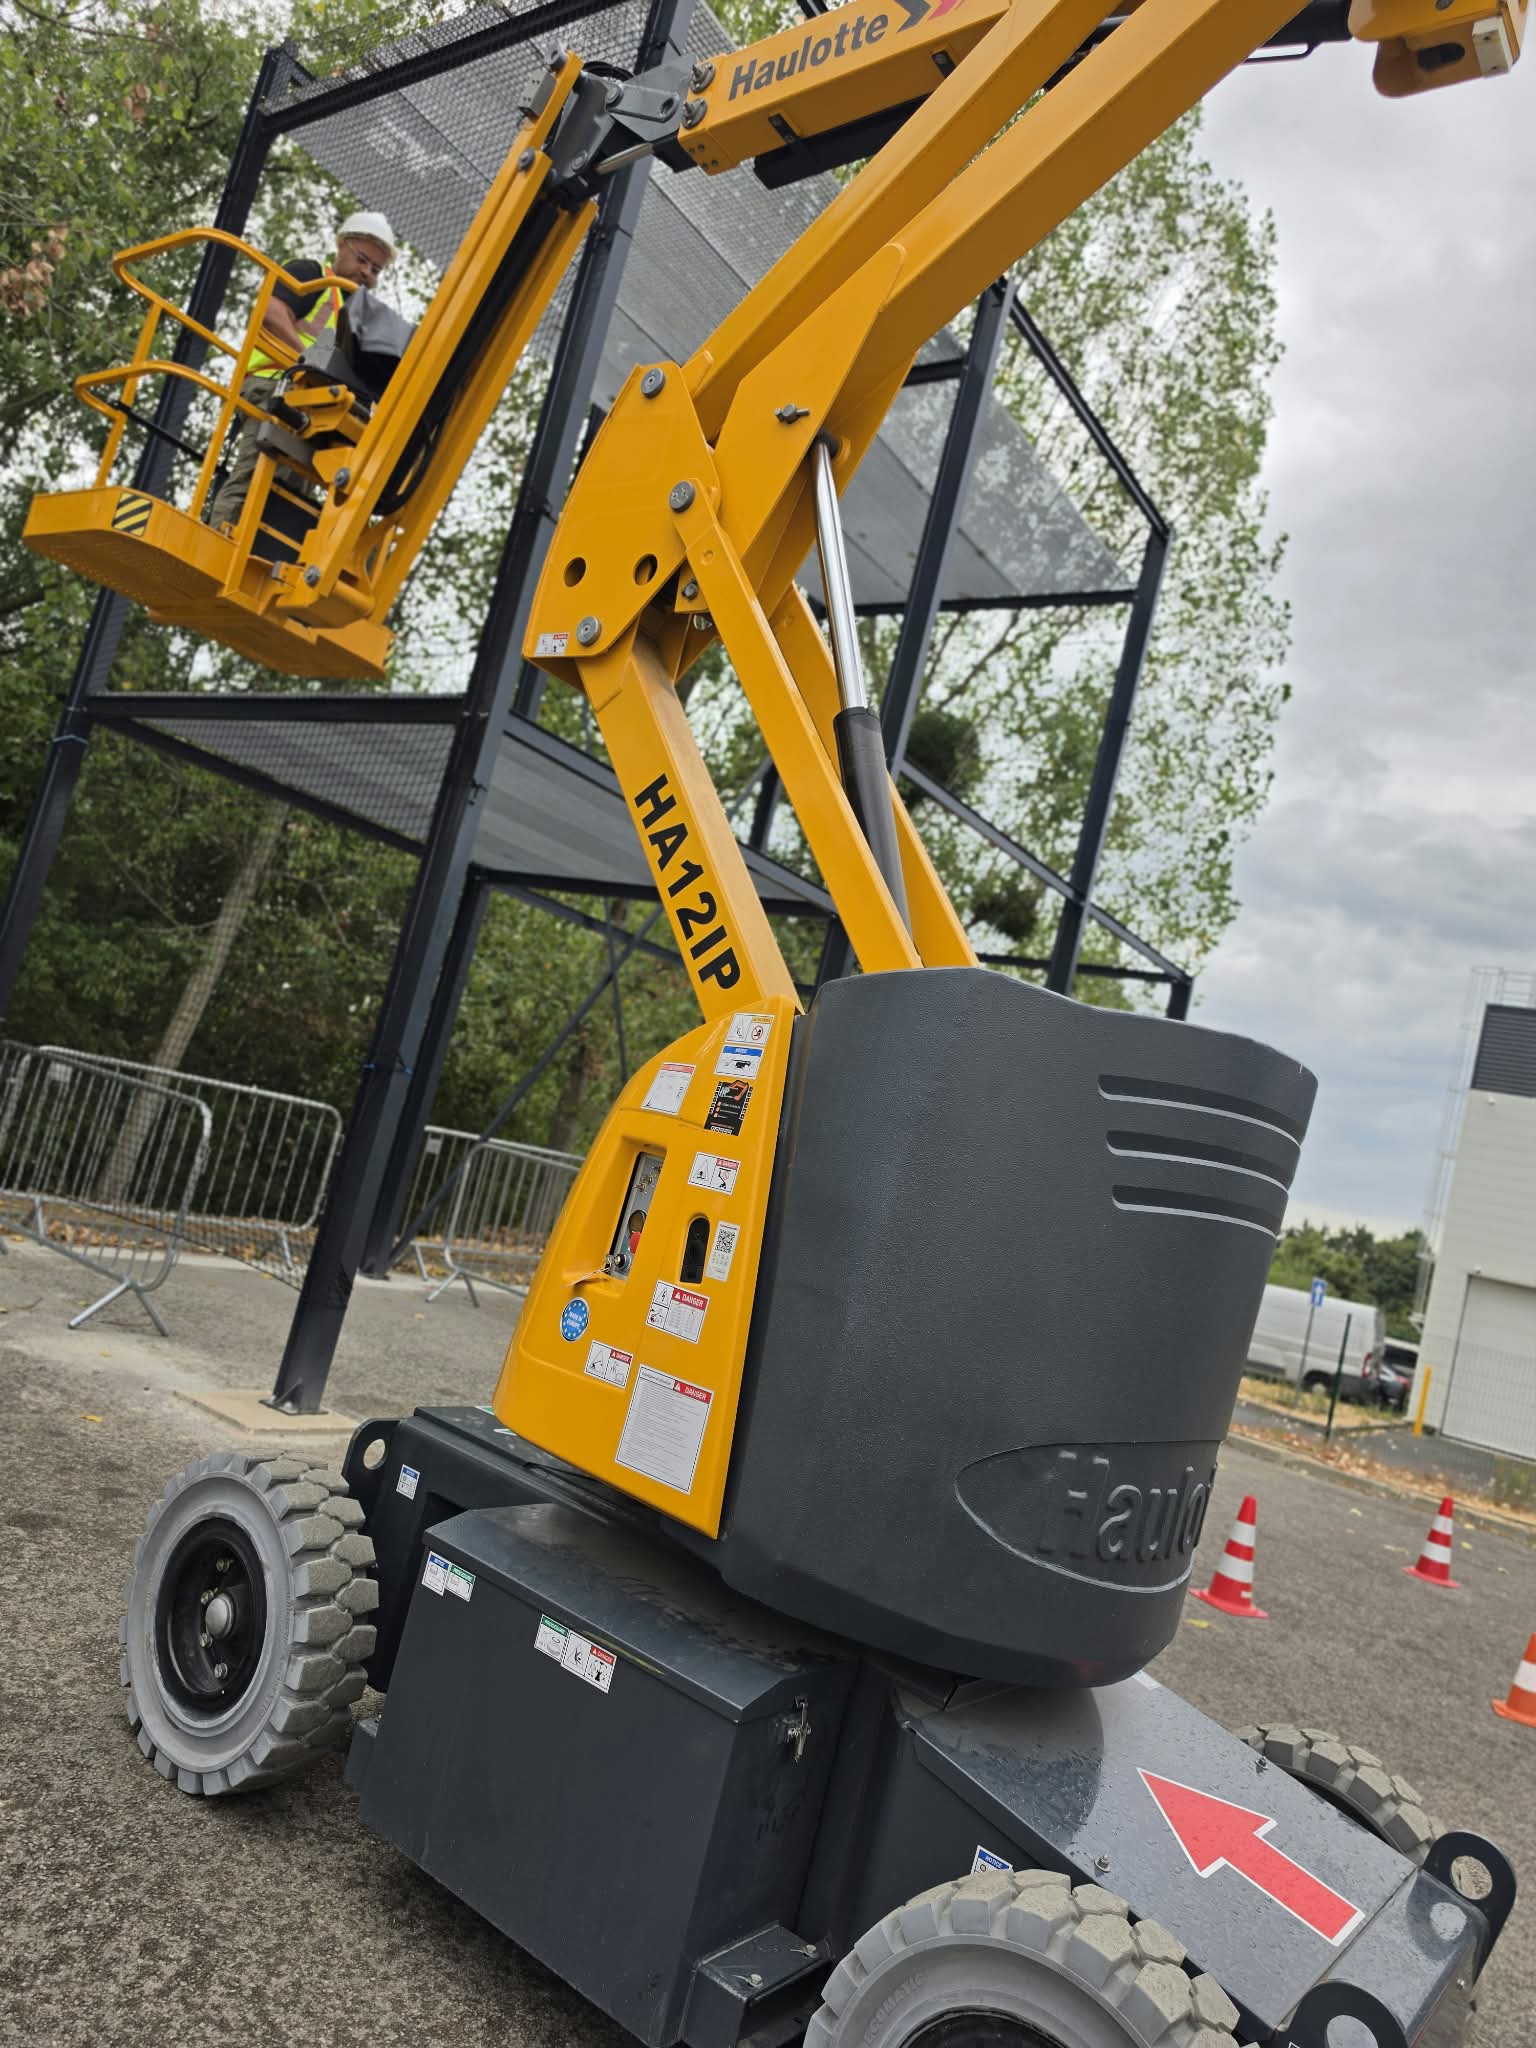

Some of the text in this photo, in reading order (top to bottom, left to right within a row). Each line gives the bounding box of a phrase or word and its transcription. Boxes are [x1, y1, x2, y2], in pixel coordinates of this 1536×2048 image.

[728, 14, 889, 101] Haulotte
[634, 773, 741, 990] HA12IP
[682, 1293, 703, 1307] DANGER
[684, 1386, 707, 1400] DANGER
